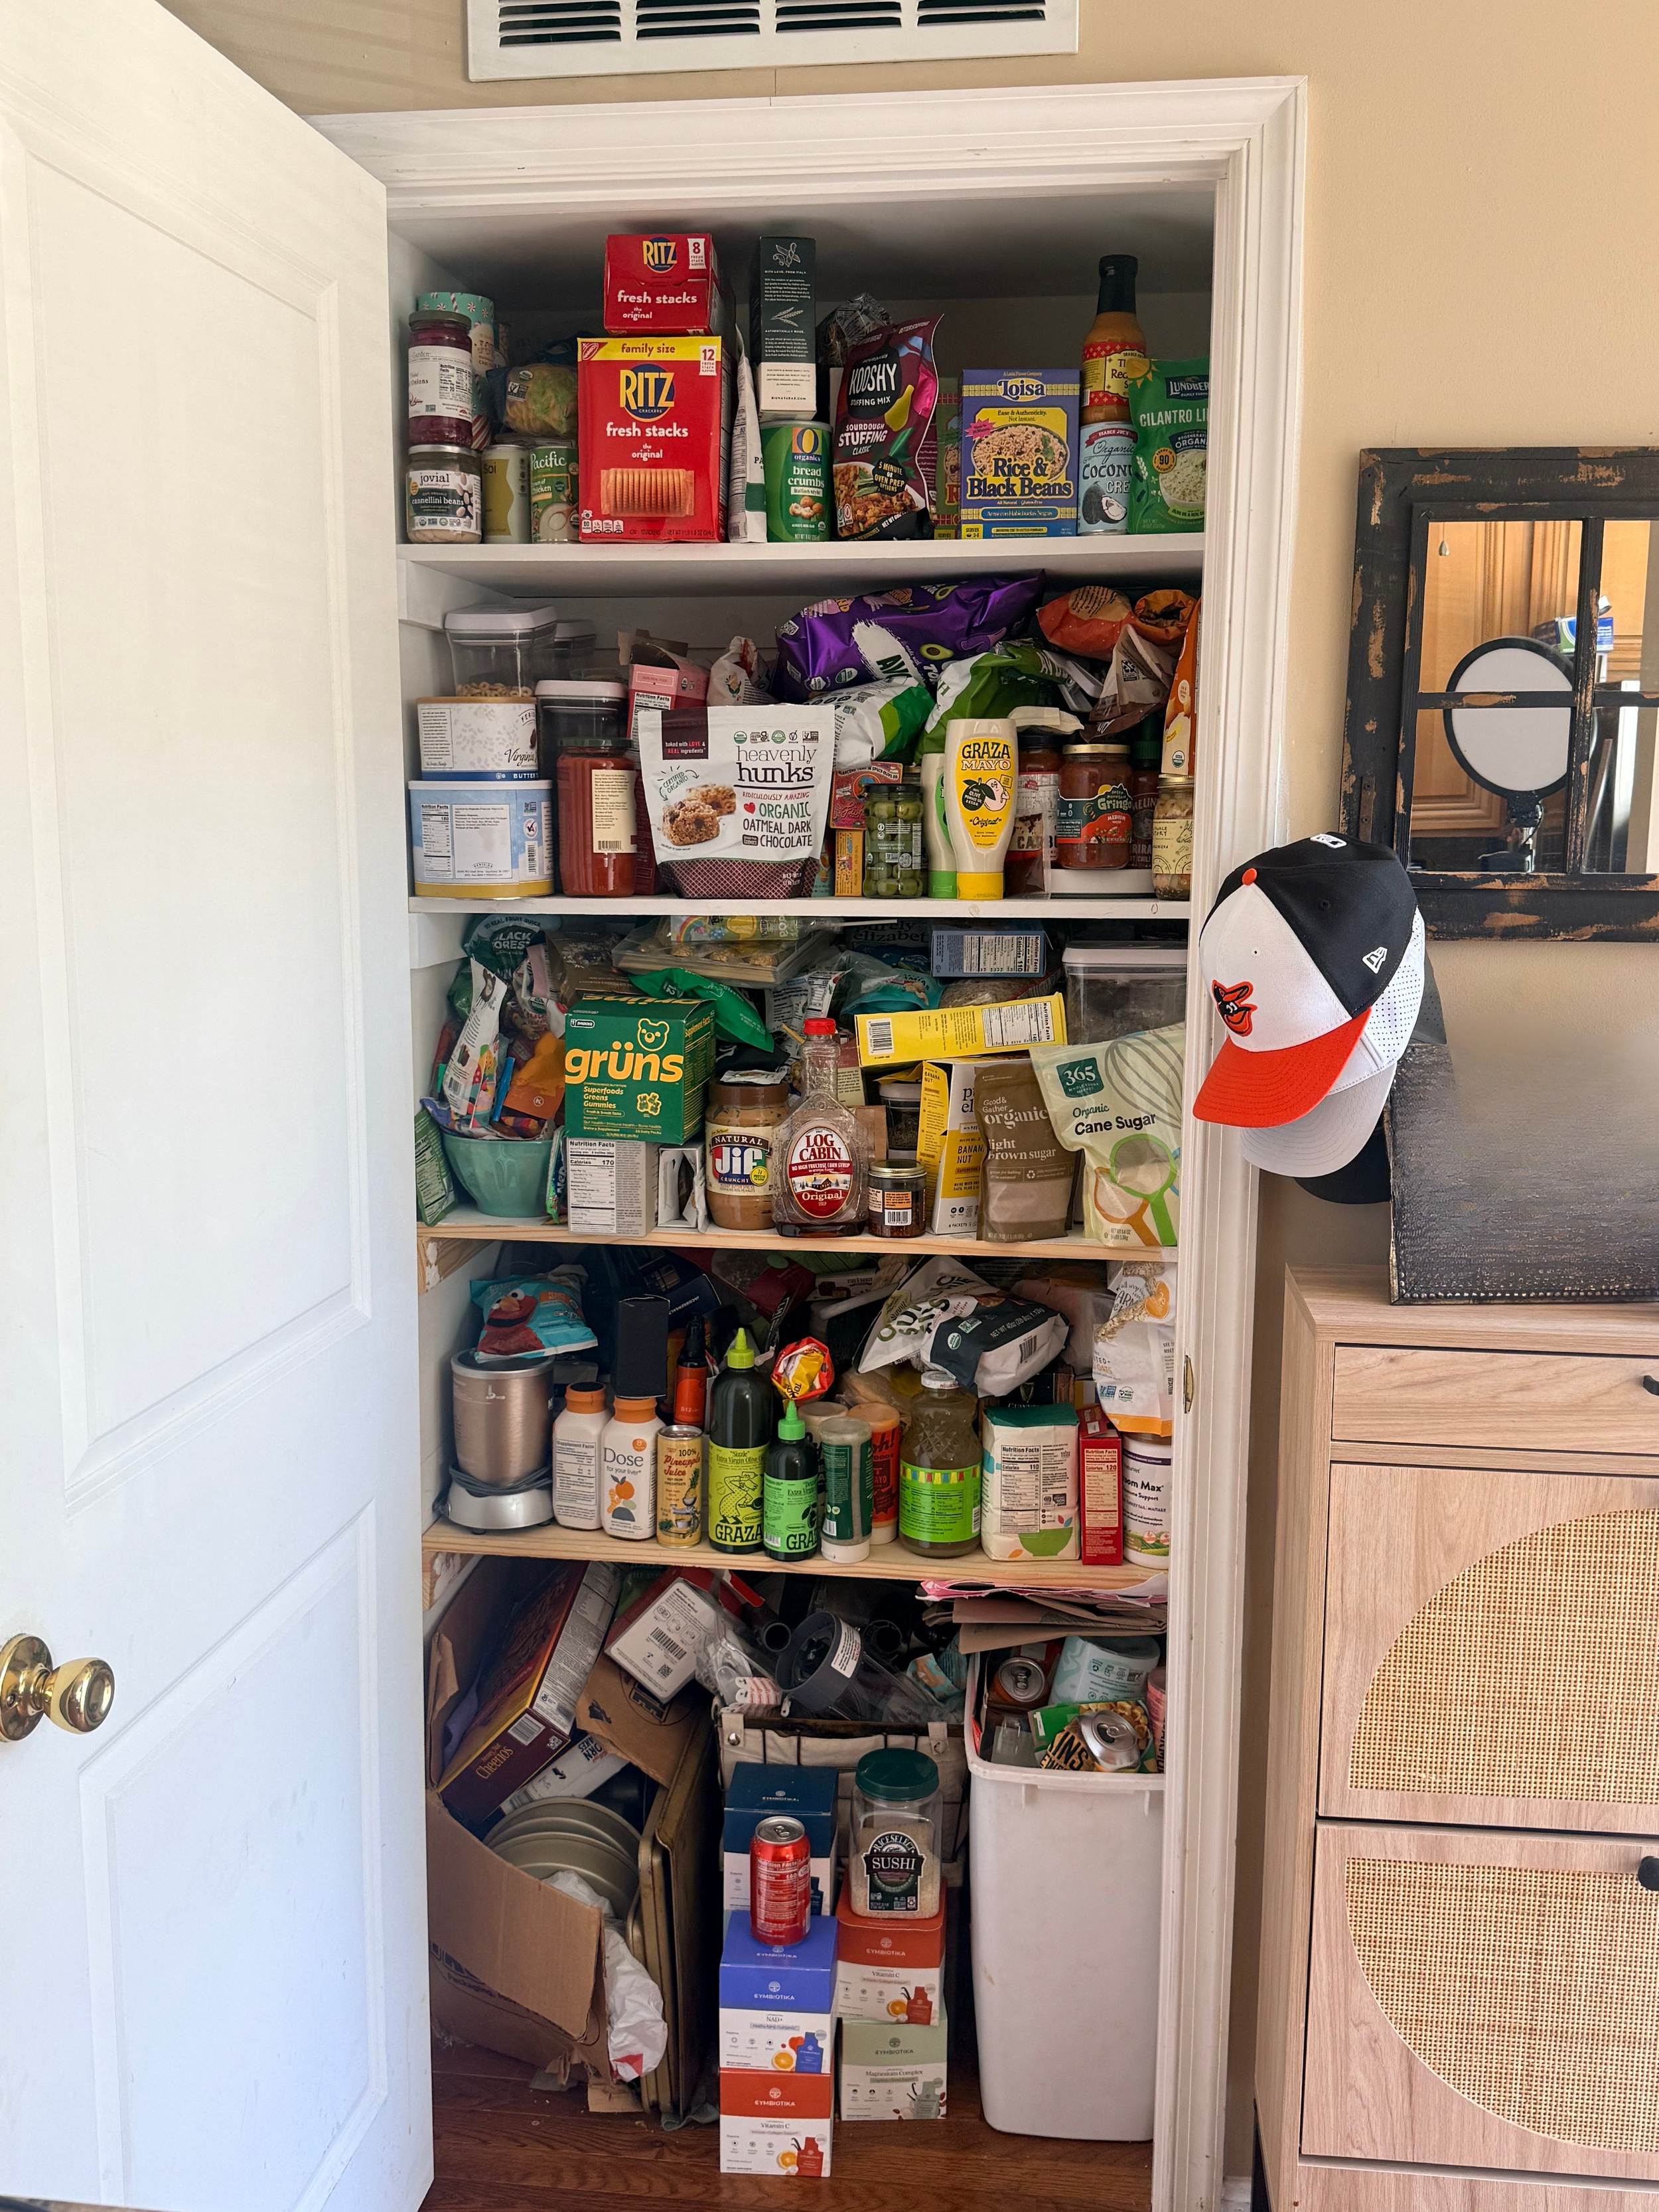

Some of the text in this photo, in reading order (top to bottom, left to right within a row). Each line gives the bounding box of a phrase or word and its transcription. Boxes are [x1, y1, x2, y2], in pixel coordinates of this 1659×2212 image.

[642, 240, 678, 266] RITZ
[693, 242, 701, 254] 8
[617, 289, 697, 304] fresh stacks
[622, 311, 652, 321] original
[621, 343, 676, 357] family size
[701, 348, 715, 361] 12
[849, 363, 897, 396] KOOSHY
[620, 369, 675, 409] RITZ
[997, 380, 1045, 400] Loisa
[877, 396, 891, 405] MIX
[1139, 409, 1193, 427] CILANTRO
[606, 422, 689, 437] fresh stacks
[846, 423, 885, 431] SOURDOUGH
[796, 427, 820, 454] O
[838, 429, 889, 447] STUFFING
[631, 449, 663, 461] original
[852, 445, 872, 456] CLASSIC
[532, 451, 567, 471] Pacific
[1159, 455, 1169, 465] 90
[792, 466, 822, 477] bread
[883, 463, 903, 476] MINUTE
[992, 457, 1049, 478] Rice &
[419, 472, 450, 486] jovial
[788, 477, 825, 488] crumbs
[875, 475, 905, 488] OVEN PREP
[879, 482, 897, 492] OPTIONS
[968, 477, 1072, 498] Black Beans
[411, 496, 465, 506] cannellini beans
[736, 745, 818, 764] heavenly
[962, 741, 1011, 759] GRAZA
[961, 759, 1012, 771] MAYO
[663, 771, 686, 788] CERTIFIED
[735, 762, 814, 783] hunks
[742, 791, 810, 802] RIDICULOUSLY AMAZING
[969, 790, 981, 799] OLIVE
[758, 801, 812, 820] ORGANIC
[1098, 797, 1132, 811] Gringo
[743, 818, 812, 835] OATMEAL DARK
[759, 834, 814, 849] CHOCOLATE
[565, 1041, 684, 1084] grüns
[924, 1071, 940, 1080] BANANA
[1062, 1065, 1096, 1086] 365
[583, 1086, 624, 1096] Superfoods
[583, 1100, 617, 1109] Gummies
[983, 1097, 1001, 1106] Good
[983, 1106, 1048, 1130] organic
[1072, 1103, 1110, 1119] Organic
[1074, 1112, 1157, 1136] Cane Sugar
[715, 1135, 763, 1145] NATURAL
[805, 1134, 834, 1147] LOG
[988, 1138, 1016, 1150] light
[715, 1146, 763, 1175] Jif
[799, 1146, 842, 1162] CABIN
[957, 1155, 972, 1164] NUT
[987, 1148, 1056, 1161] brown sugar
[802, 1189, 843, 1202] Original
[557, 1440, 582, 1449] Supplement
[603, 1447, 644, 1467] Dose
[678, 1448, 697, 1457] 100%
[716, 1454, 758, 1465] Extra Virgin Olive
[664, 1464, 687, 1477] Juice
[787, 1488, 802, 1497] Extra
[1141, 1479, 1162, 1493] Max
[715, 1522, 764, 1543] GRAZA
[474, 1745, 514, 1780] Cheerios
[873, 1834, 916, 1853] RICESELECT
[871, 1856, 916, 1871] SUSHI
[871, 1970, 895, 1978] Vitamin
[898, 2068, 924, 2078] Complex
